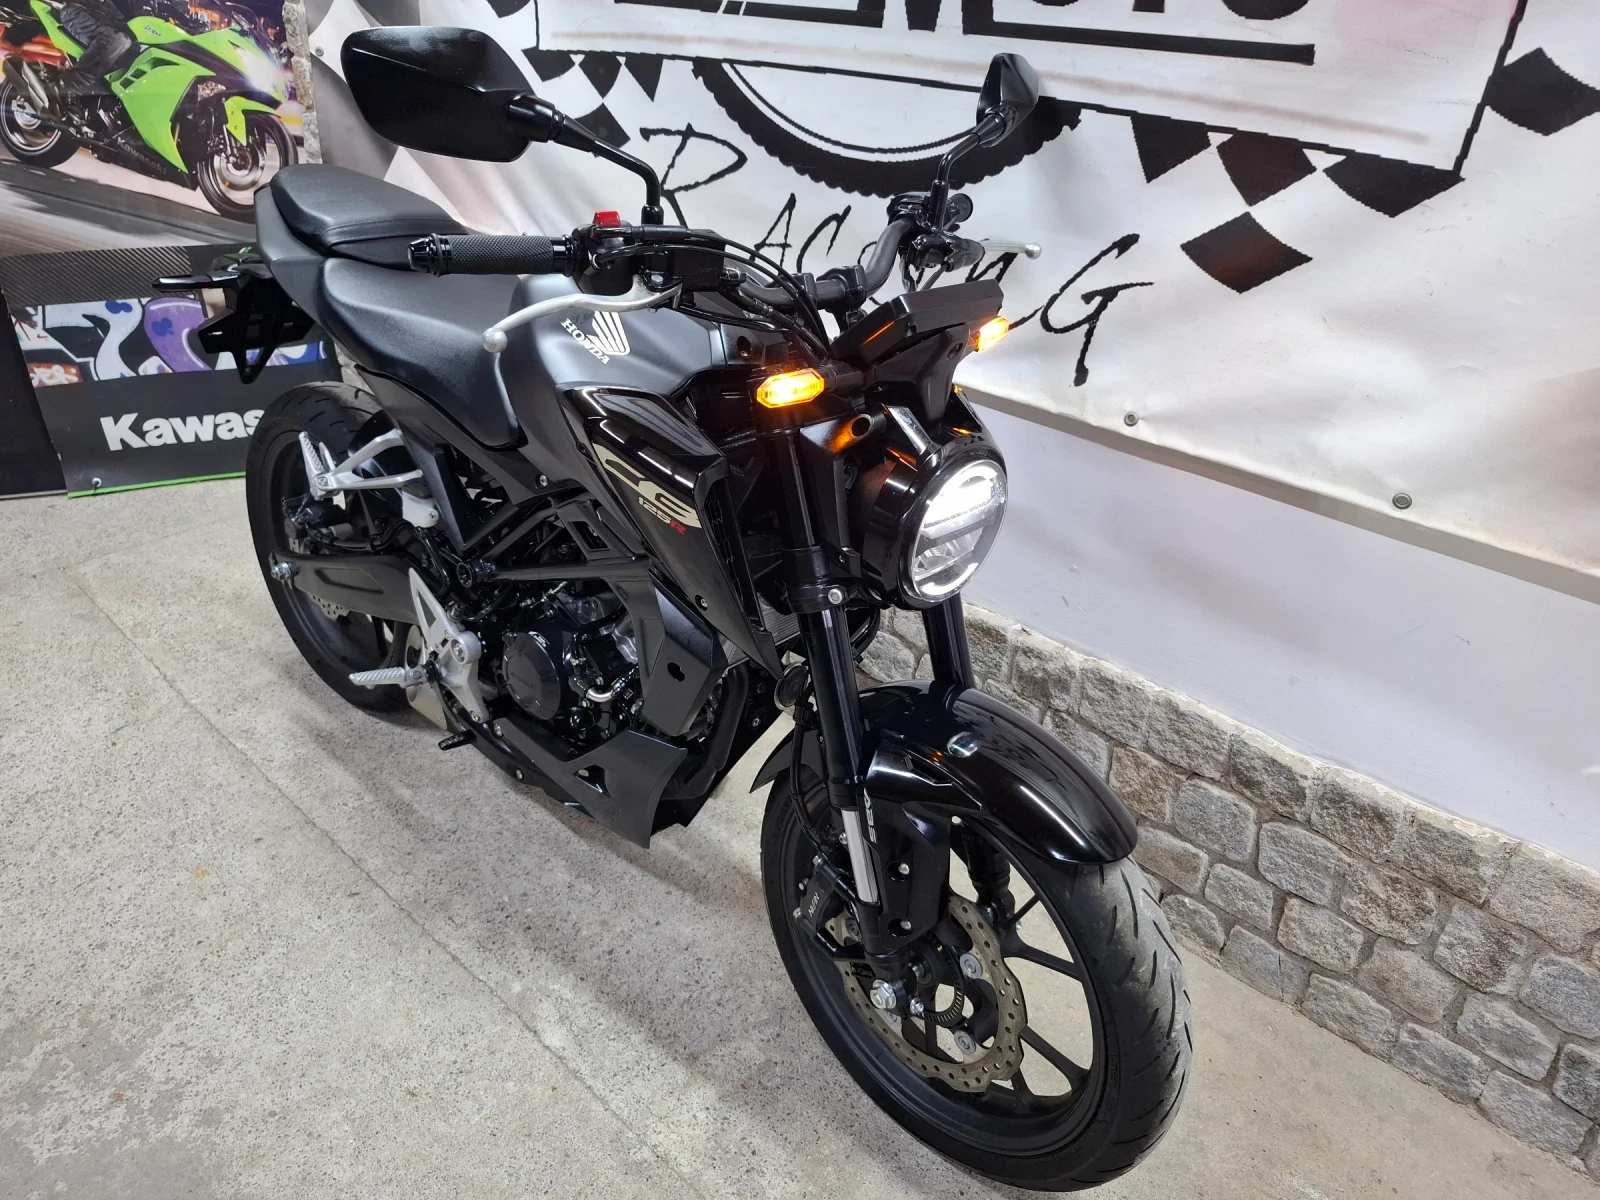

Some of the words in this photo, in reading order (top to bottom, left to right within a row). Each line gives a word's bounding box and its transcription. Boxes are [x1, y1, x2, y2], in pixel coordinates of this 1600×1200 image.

[561, 317, 610, 365] HONDA
[100, 409, 265, 451] Kawas
[639, 496, 687, 536] 125R
[863, 787, 877, 844] ABS
